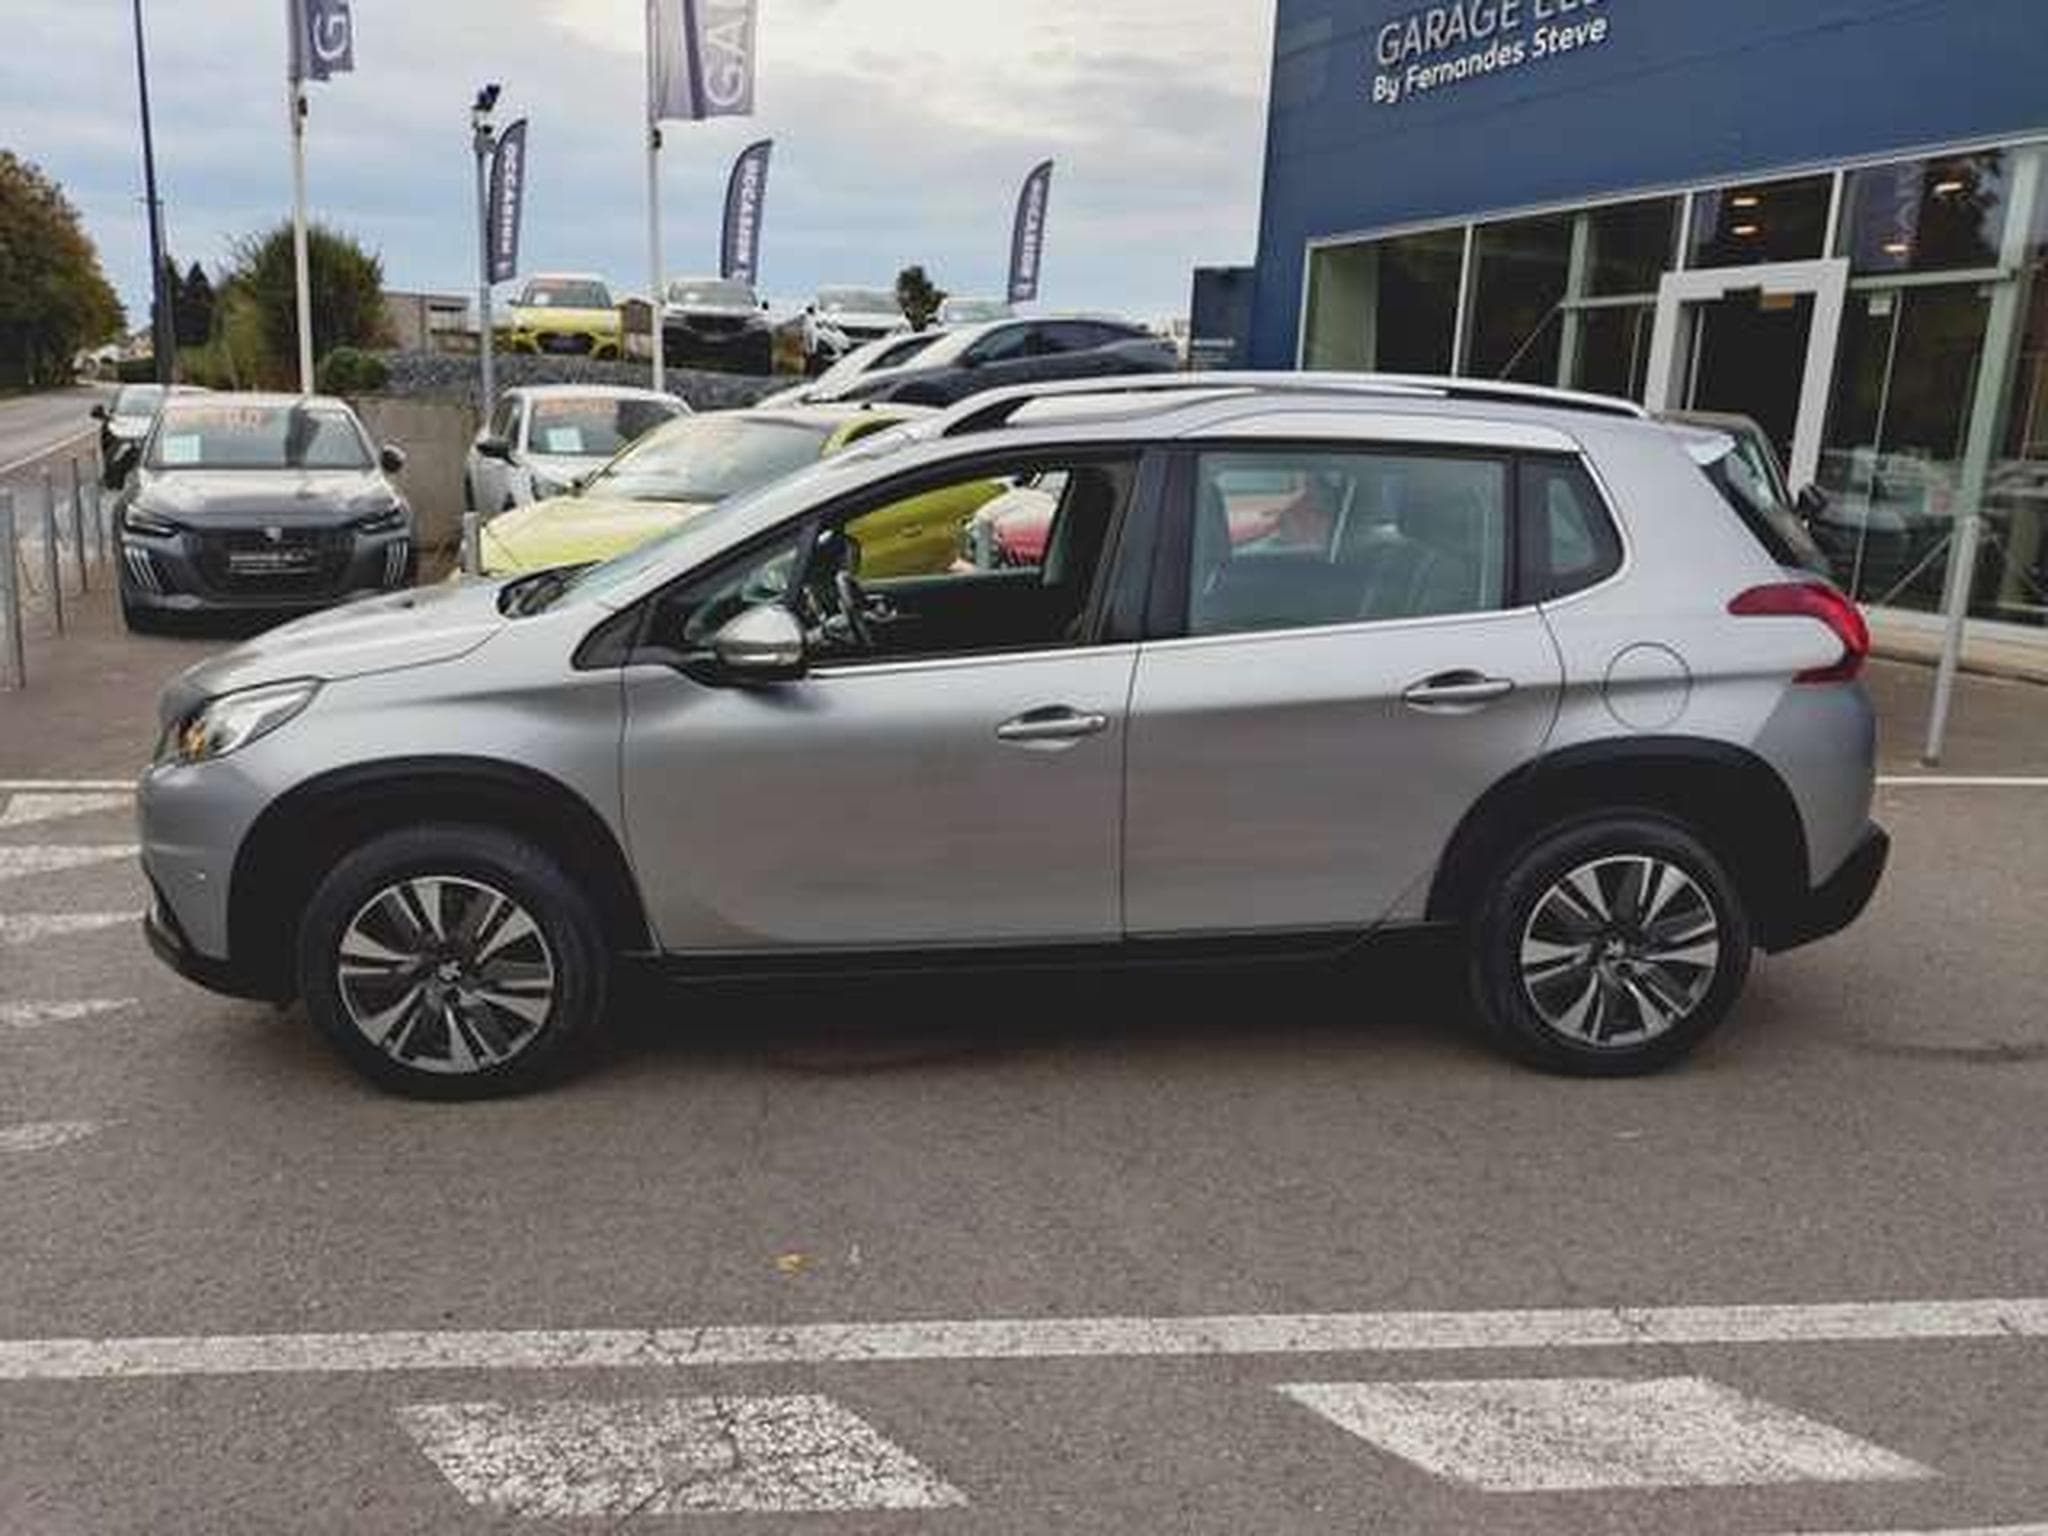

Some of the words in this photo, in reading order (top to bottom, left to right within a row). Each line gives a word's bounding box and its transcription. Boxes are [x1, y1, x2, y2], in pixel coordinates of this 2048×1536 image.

[702, 0, 746, 107] GA
[1372, 75, 1400, 103] By
[1405, 39, 1526, 93] Fernandes
[1531, 16, 1608, 58] Steve
[1376, 0, 1521, 66] GARAGE
